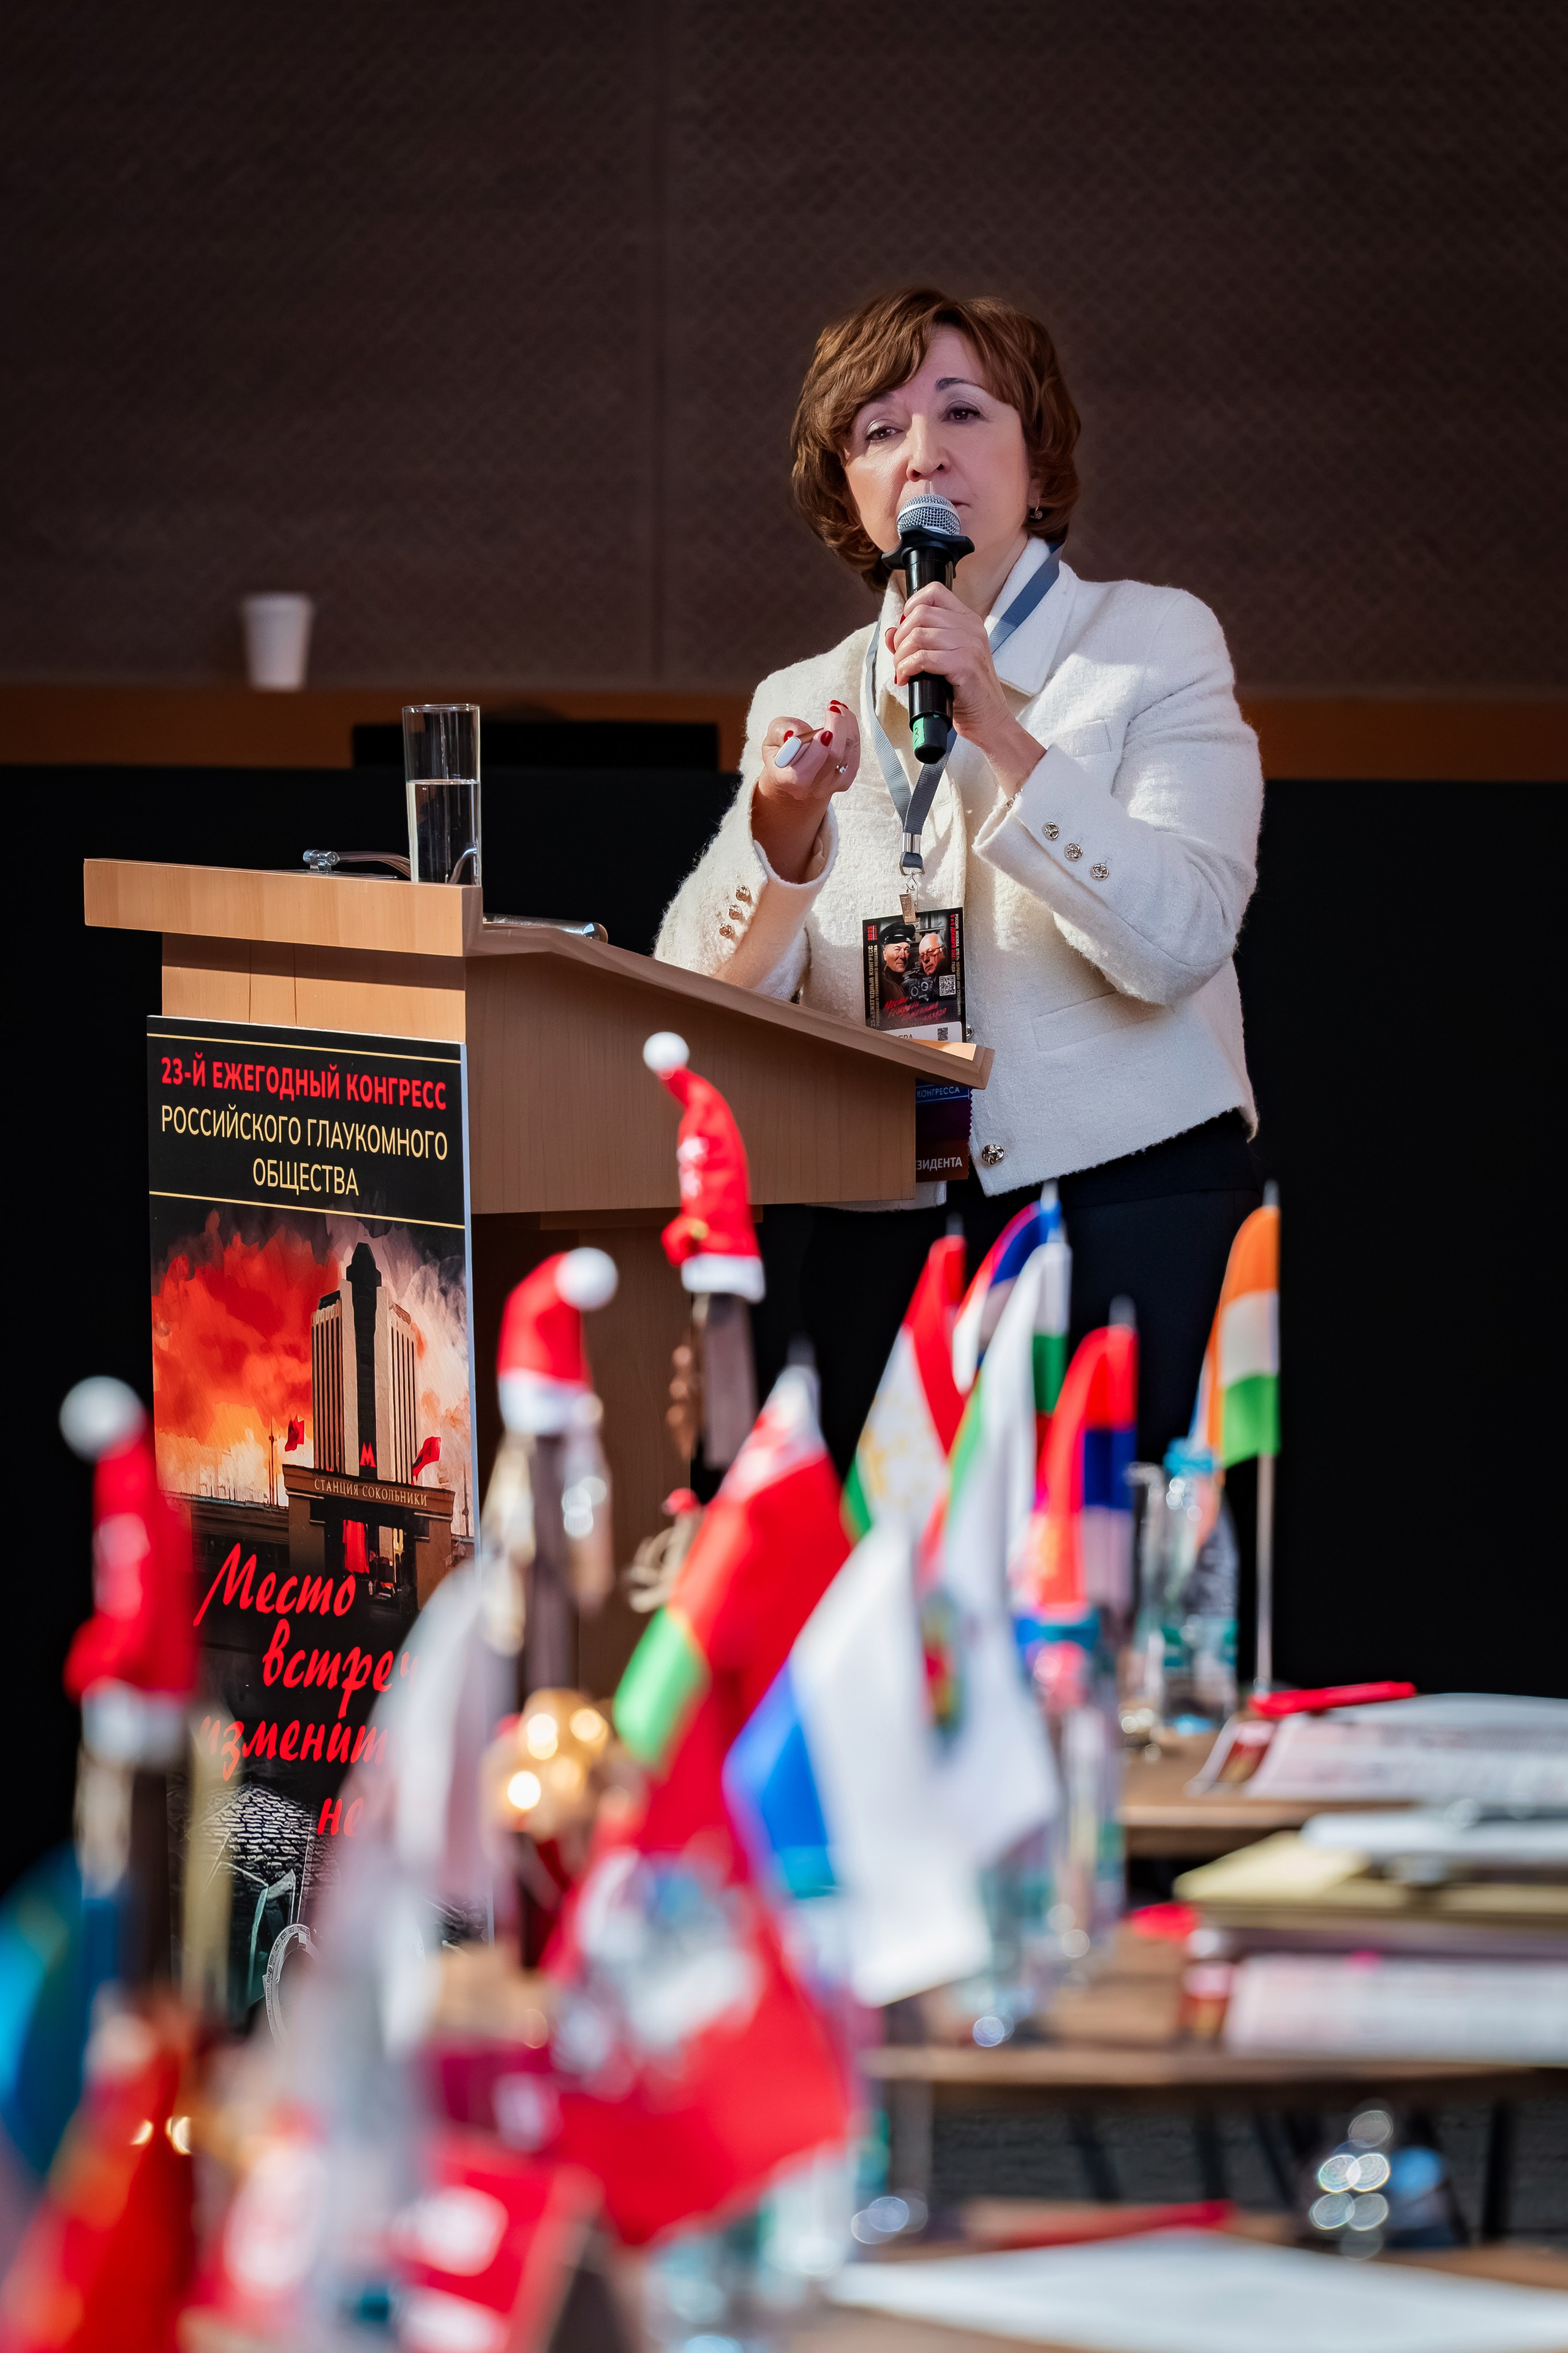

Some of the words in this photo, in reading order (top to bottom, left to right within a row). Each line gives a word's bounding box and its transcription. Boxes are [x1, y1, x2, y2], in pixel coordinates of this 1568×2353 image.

[161, 1052, 206, 1087] 23-Й
[213, 1061, 341, 1101] ЕЖЕГОДНЫЙ
[347, 1073, 447, 1110] КОНГРЕСС
[916, 1086, 960, 1098] КОНГРЕССА
[161, 1103, 301, 1145] РОССИЙСКОГО
[307, 1118, 448, 1160] ГЛАУКОМНОГО
[253, 1158, 360, 1196] ОБЩЕСТВА
[916, 1157, 963, 1172] ЗИДЕНТА
[314, 1478, 359, 1497] СТАНЦИЯ
[361, 1485, 428, 1507] СОКОЛЬНИКИ
[194, 1542, 356, 1627] Место
[262, 1618, 420, 1720] встреч
[200, 1715, 389, 1782] изменит
